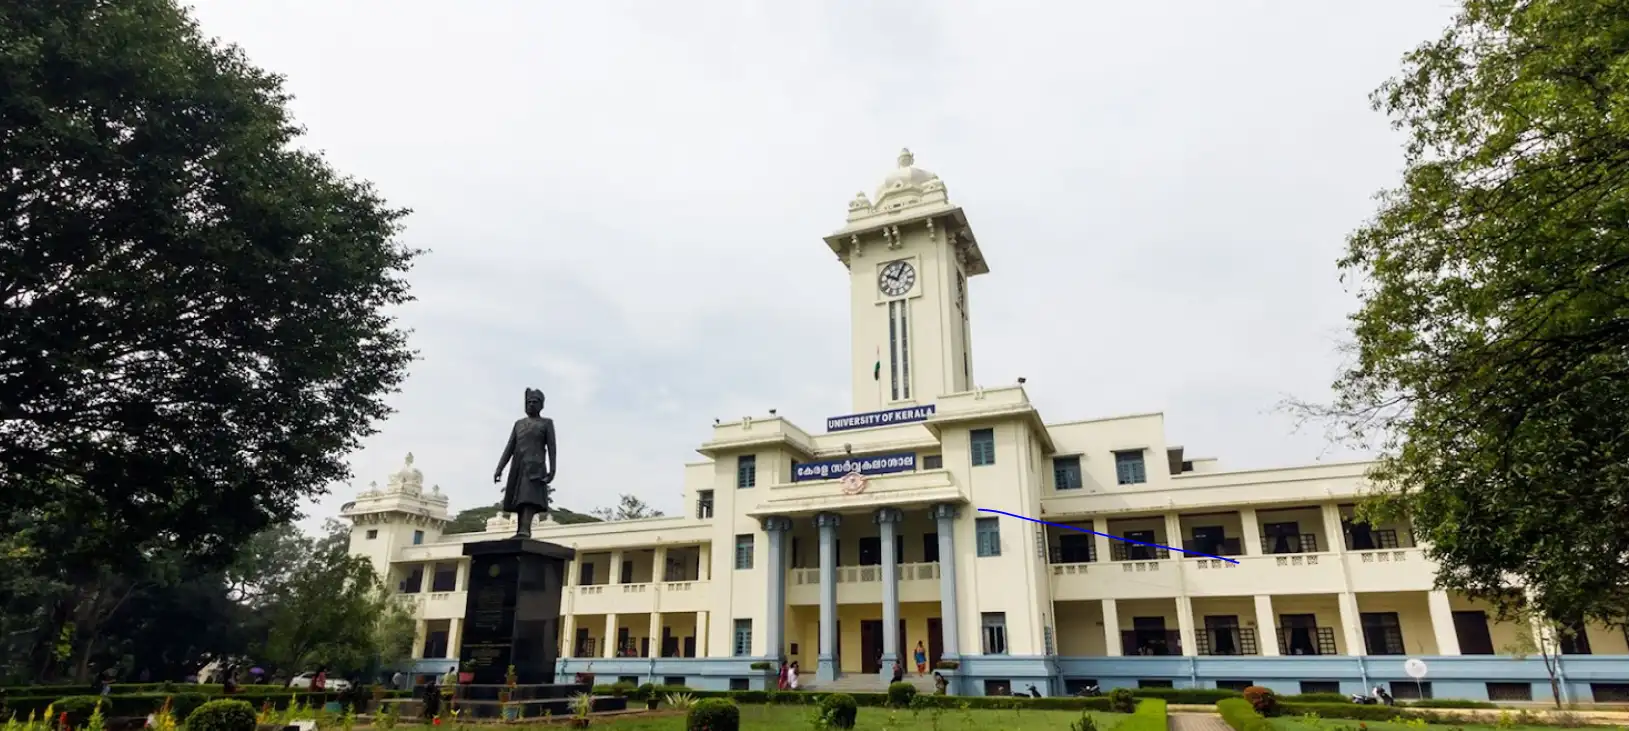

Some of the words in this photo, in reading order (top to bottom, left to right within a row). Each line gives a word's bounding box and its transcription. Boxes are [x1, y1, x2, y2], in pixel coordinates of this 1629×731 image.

[828, 415, 881, 429] UNIVERSITY
[881, 413, 893, 422] OF
[895, 408, 933, 420] KERALA
[797, 465, 828, 476] കേരള
